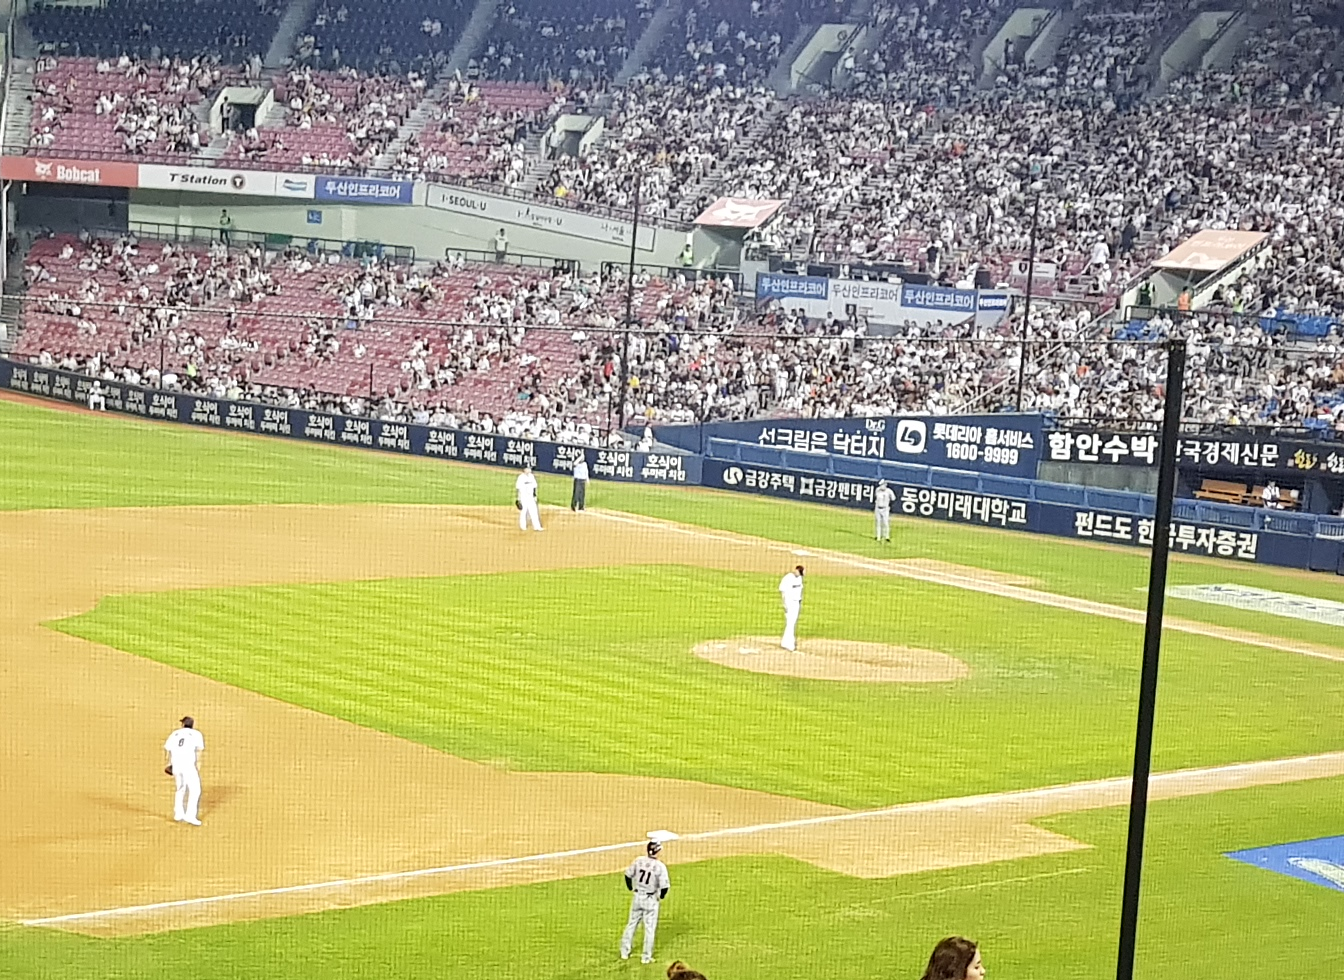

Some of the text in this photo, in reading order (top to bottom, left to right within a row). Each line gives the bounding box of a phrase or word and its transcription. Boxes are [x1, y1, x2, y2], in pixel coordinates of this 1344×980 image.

[56, 165, 102, 184] Bobcat
[180, 174, 228, 187] Station
[758, 427, 886, 459] 선크림은 닥터지
[933, 422, 1035, 450] 롯데리아 홈서비스
[1047, 432, 1159, 465] 함안수박
[945, 442, 1019, 465] 1600-9999
[1175, 439, 1280, 468] 국경제신문
[744, 468, 796, 493] 금강주택
[814, 478, 877, 503] 금강펜테리
[901, 486, 1028, 526] 동양미래대학교
[1075, 511, 1133, 540] 펀드도
[639, 869, 652, 885] 71
